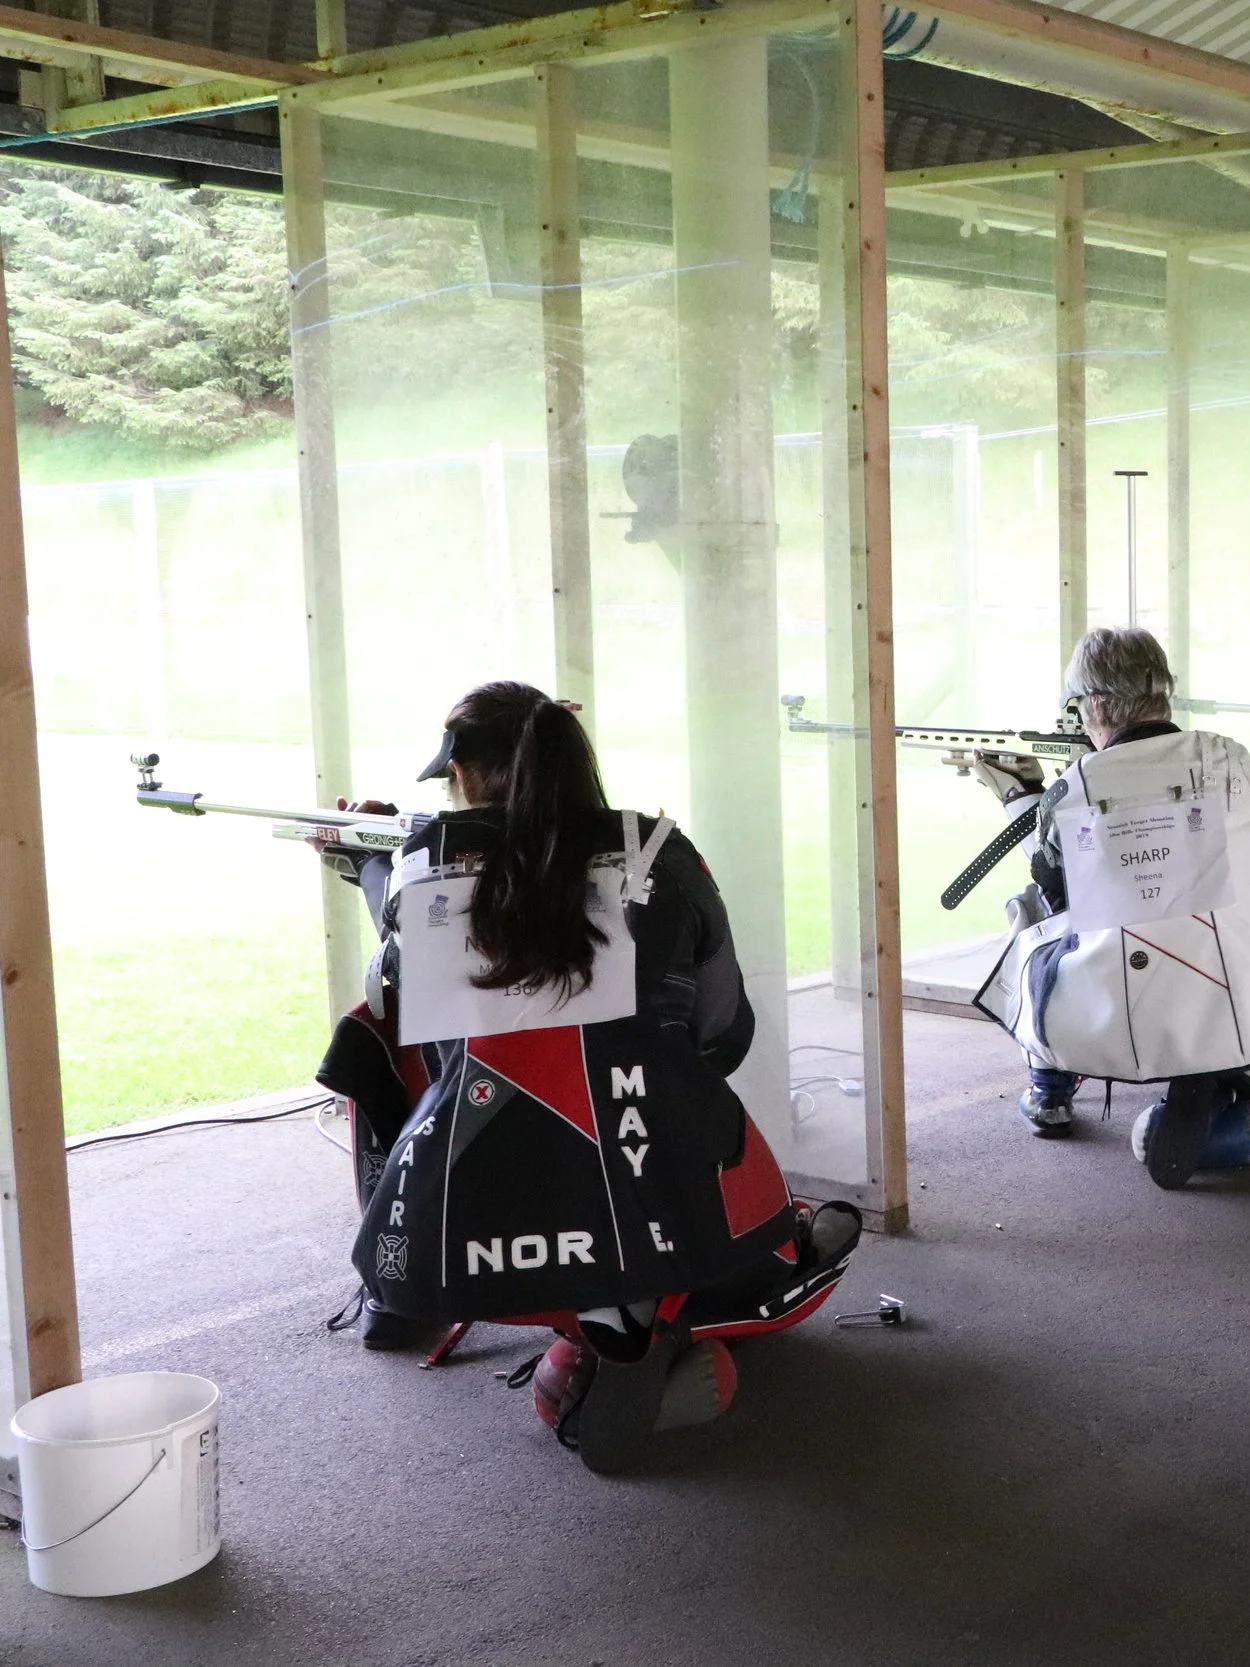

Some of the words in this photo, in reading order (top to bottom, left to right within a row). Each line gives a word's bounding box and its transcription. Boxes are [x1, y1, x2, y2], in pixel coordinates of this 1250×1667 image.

[318, 828, 339, 842] ELEY
[1120, 847, 1171, 867] SHARP
[1134, 872, 1163, 882] Sheena
[1140, 886, 1161, 900] 127
[503, 983, 532, 997] 136
[610, 1065, 651, 1178] MAY
[466, 1230, 597, 1276] NOR
